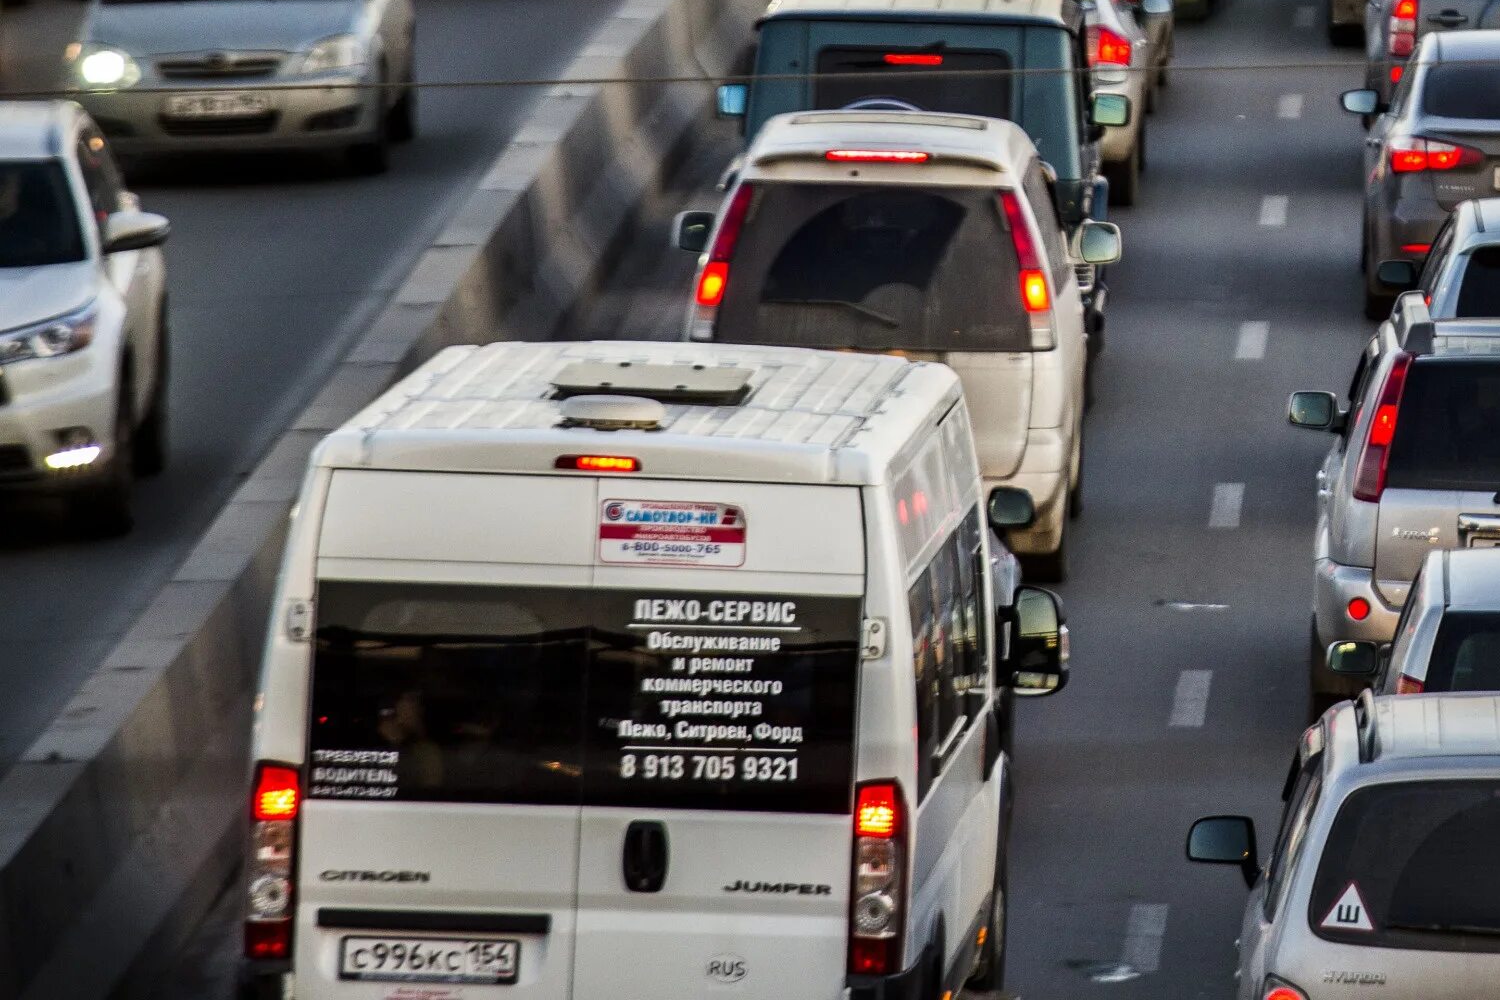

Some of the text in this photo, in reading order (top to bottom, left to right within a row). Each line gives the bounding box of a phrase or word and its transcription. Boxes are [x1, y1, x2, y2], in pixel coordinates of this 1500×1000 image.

[634, 599, 797, 623] ПЕЖО-СЕРВИС
[647, 631, 781, 652] Обслуживание
[672, 657, 754, 674] и ремонт
[641, 678, 783, 696] коммерческого
[660, 699, 763, 718] транспорта
[617, 719, 804, 743] Пежо, Ситроен, Форд
[620, 754, 799, 780] 8 913 705 9321
[722, 879, 833, 896] JUMPER
[1337, 905, 1360, 923] Ш
[465, 941, 510, 965] 154
[706, 960, 747, 977] RUS
